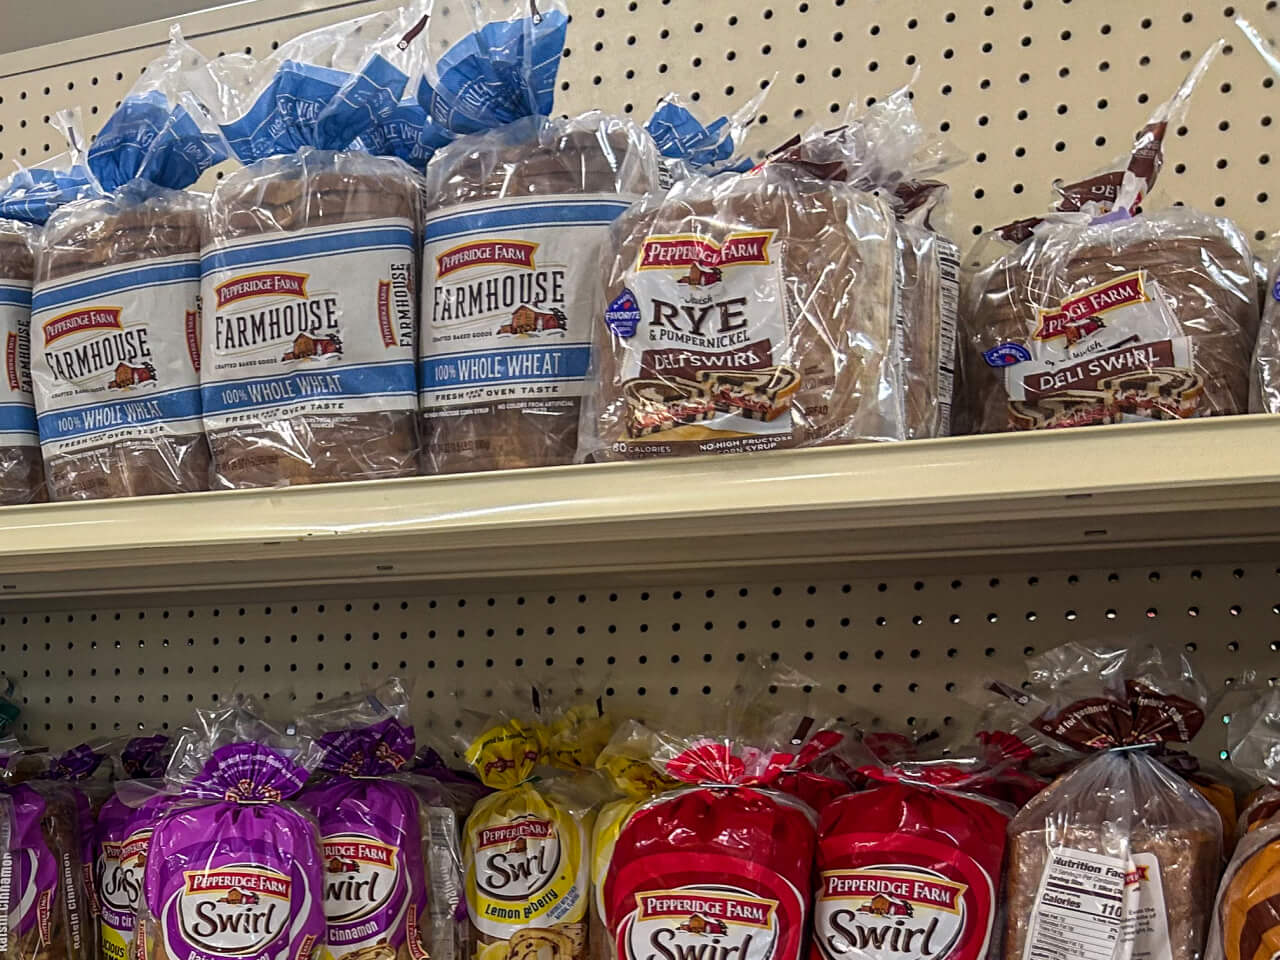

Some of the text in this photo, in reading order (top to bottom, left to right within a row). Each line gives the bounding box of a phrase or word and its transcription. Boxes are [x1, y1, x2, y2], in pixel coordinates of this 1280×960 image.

[441, 245, 527, 270] PEPPERIDGE FARM
[721, 242, 760, 261] FARM
[219, 275, 299, 301] PEPPERIDGE FARM
[432, 270, 564, 322] FARMHOUSE
[1090, 284, 1136, 308] FARM
[89, 311, 116, 327] FARM
[215, 298, 339, 350] FARMHOUSE
[649, 297, 747, 336] RYE
[660, 329, 750, 348] PUMPERNICKEL
[44, 328, 151, 382] FARMHOUSE
[435, 353, 561, 381] 100% WHOLE WHEAT
[1039, 347, 1160, 392] DELI SWIRL
[222, 375, 342, 404] 100% WHOLE WHEAT
[57, 401, 162, 432] 100% WHOLE WHEAT
[358, 846, 388, 861] FARM
[1053, 856, 1102, 874] Nutrition
[0, 852, 13, 913] Cinnamon
[192, 875, 288, 894] PEPPERIDGE FARM
[828, 876, 951, 904] PEPPERIDGE FARM
[484, 903, 521, 920] Lemon
[646, 898, 764, 921] PEPPERIDGE FARM
[1042, 893, 1082, 908] Calories
[192, 901, 277, 938] Swirl
[828, 909, 939, 956] Swirl
